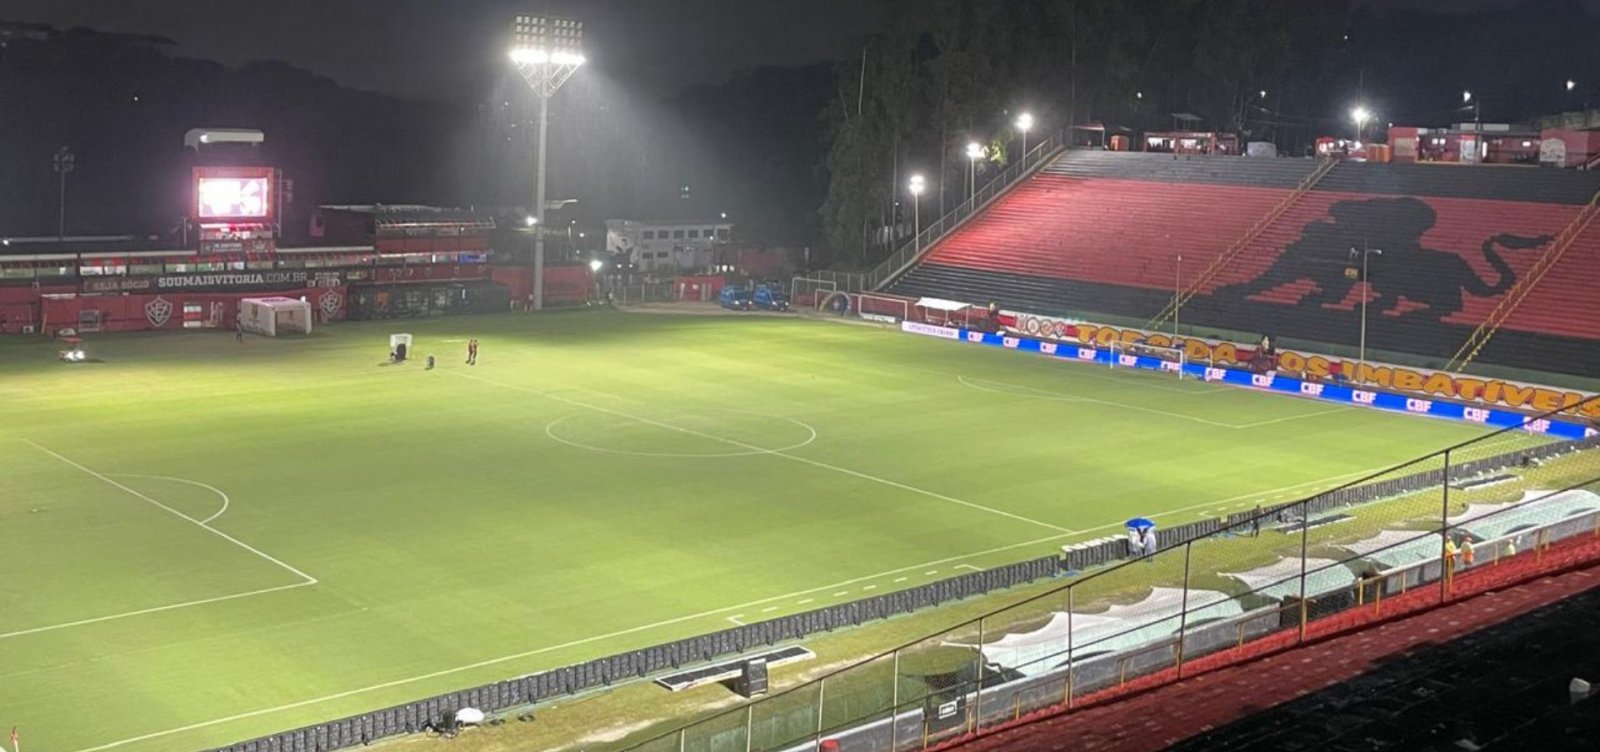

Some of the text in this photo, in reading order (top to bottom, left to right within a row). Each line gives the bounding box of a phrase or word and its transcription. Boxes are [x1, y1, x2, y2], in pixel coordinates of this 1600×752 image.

[1279, 350, 1330, 377] OS
[1119, 354, 1138, 367] CBF
[1252, 374, 1275, 387] CBF
[1301, 382, 1325, 395] CBF
[1352, 390, 1377, 403] CBF
[1406, 398, 1433, 412] CBF
[1463, 407, 1491, 423] CBF
